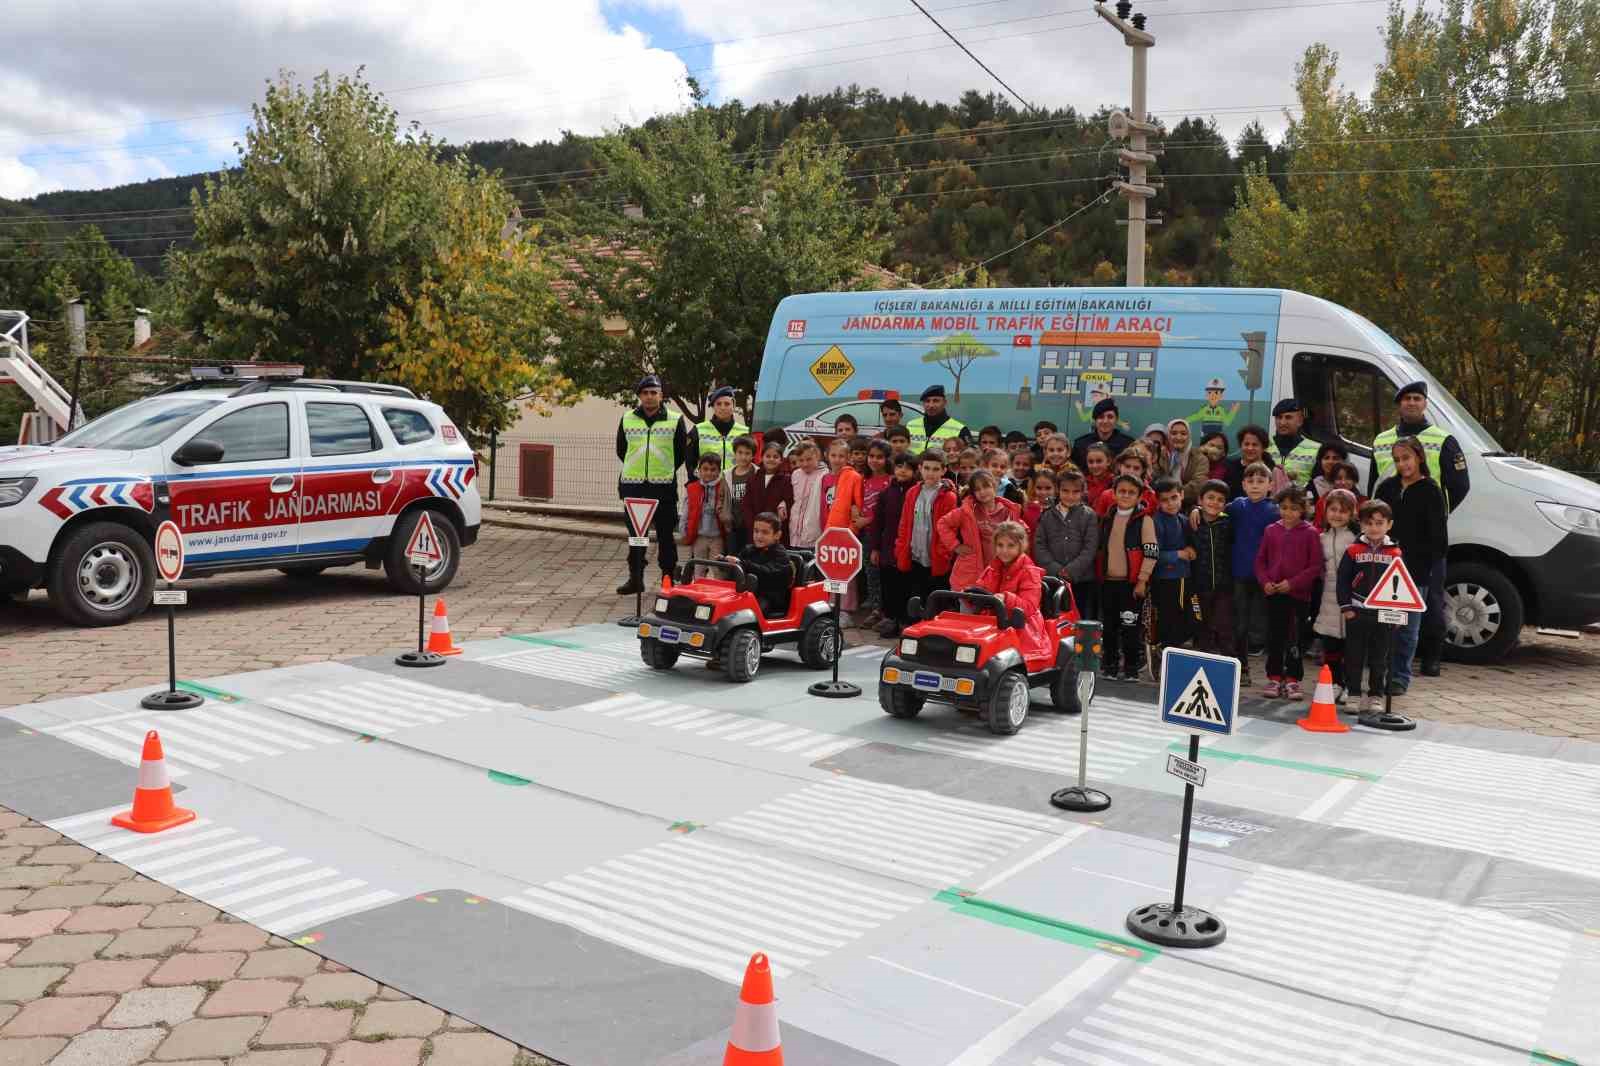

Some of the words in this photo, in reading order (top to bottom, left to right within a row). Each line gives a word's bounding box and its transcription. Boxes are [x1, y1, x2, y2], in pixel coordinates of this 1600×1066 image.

[920, 299, 983, 311] BAKANLIĞI
[986, 301, 995, 311] &
[1081, 298, 1152, 311] BAKANLIĞI
[842, 316, 925, 331] JANDARMA
[930, 314, 979, 331] MOBİL
[986, 315, 1045, 331] TRAFİK
[1115, 316, 1172, 332] ARACI
[264, 490, 381, 521] JANDARMASI
[188, 528, 288, 547] www.jandarma.gov.tr
[819, 545, 858, 565] STOP
